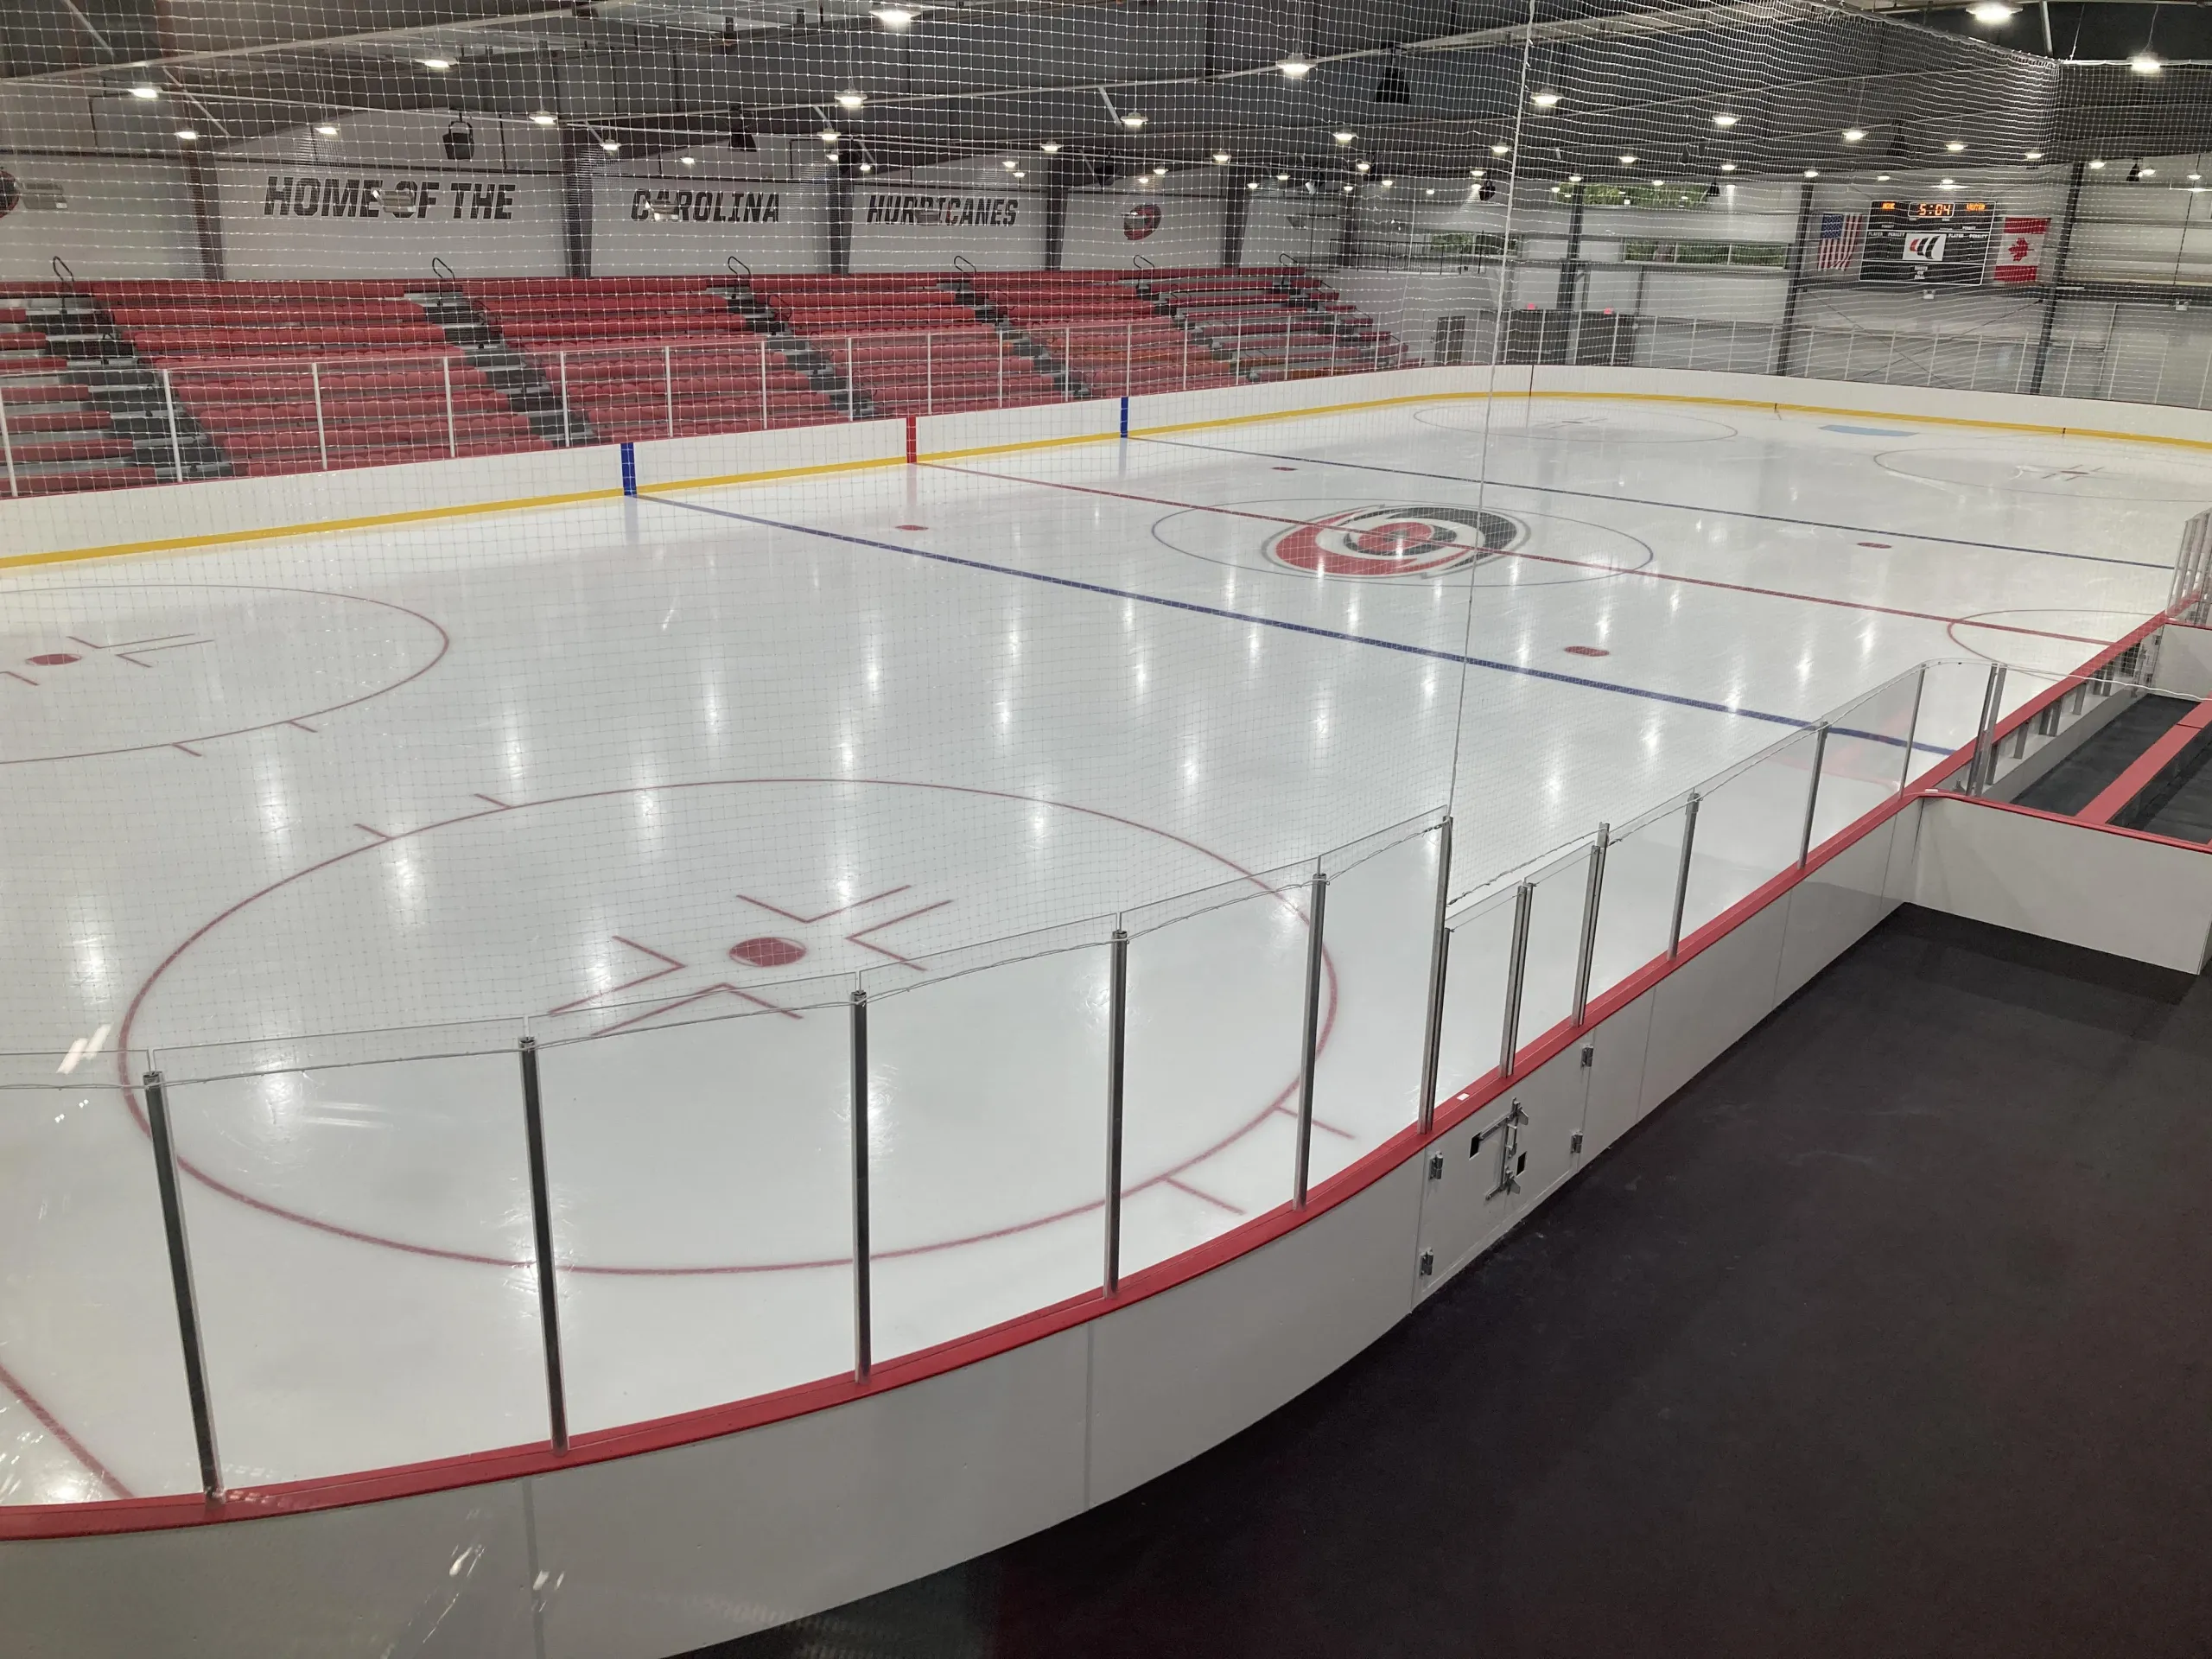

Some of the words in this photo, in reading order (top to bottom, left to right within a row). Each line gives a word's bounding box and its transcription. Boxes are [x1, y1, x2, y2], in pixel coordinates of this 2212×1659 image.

[264, 175, 383, 218] HOME
[392, 180, 439, 219] OF
[451, 182, 516, 219] THE
[1918, 203, 1951, 215] 5:04
